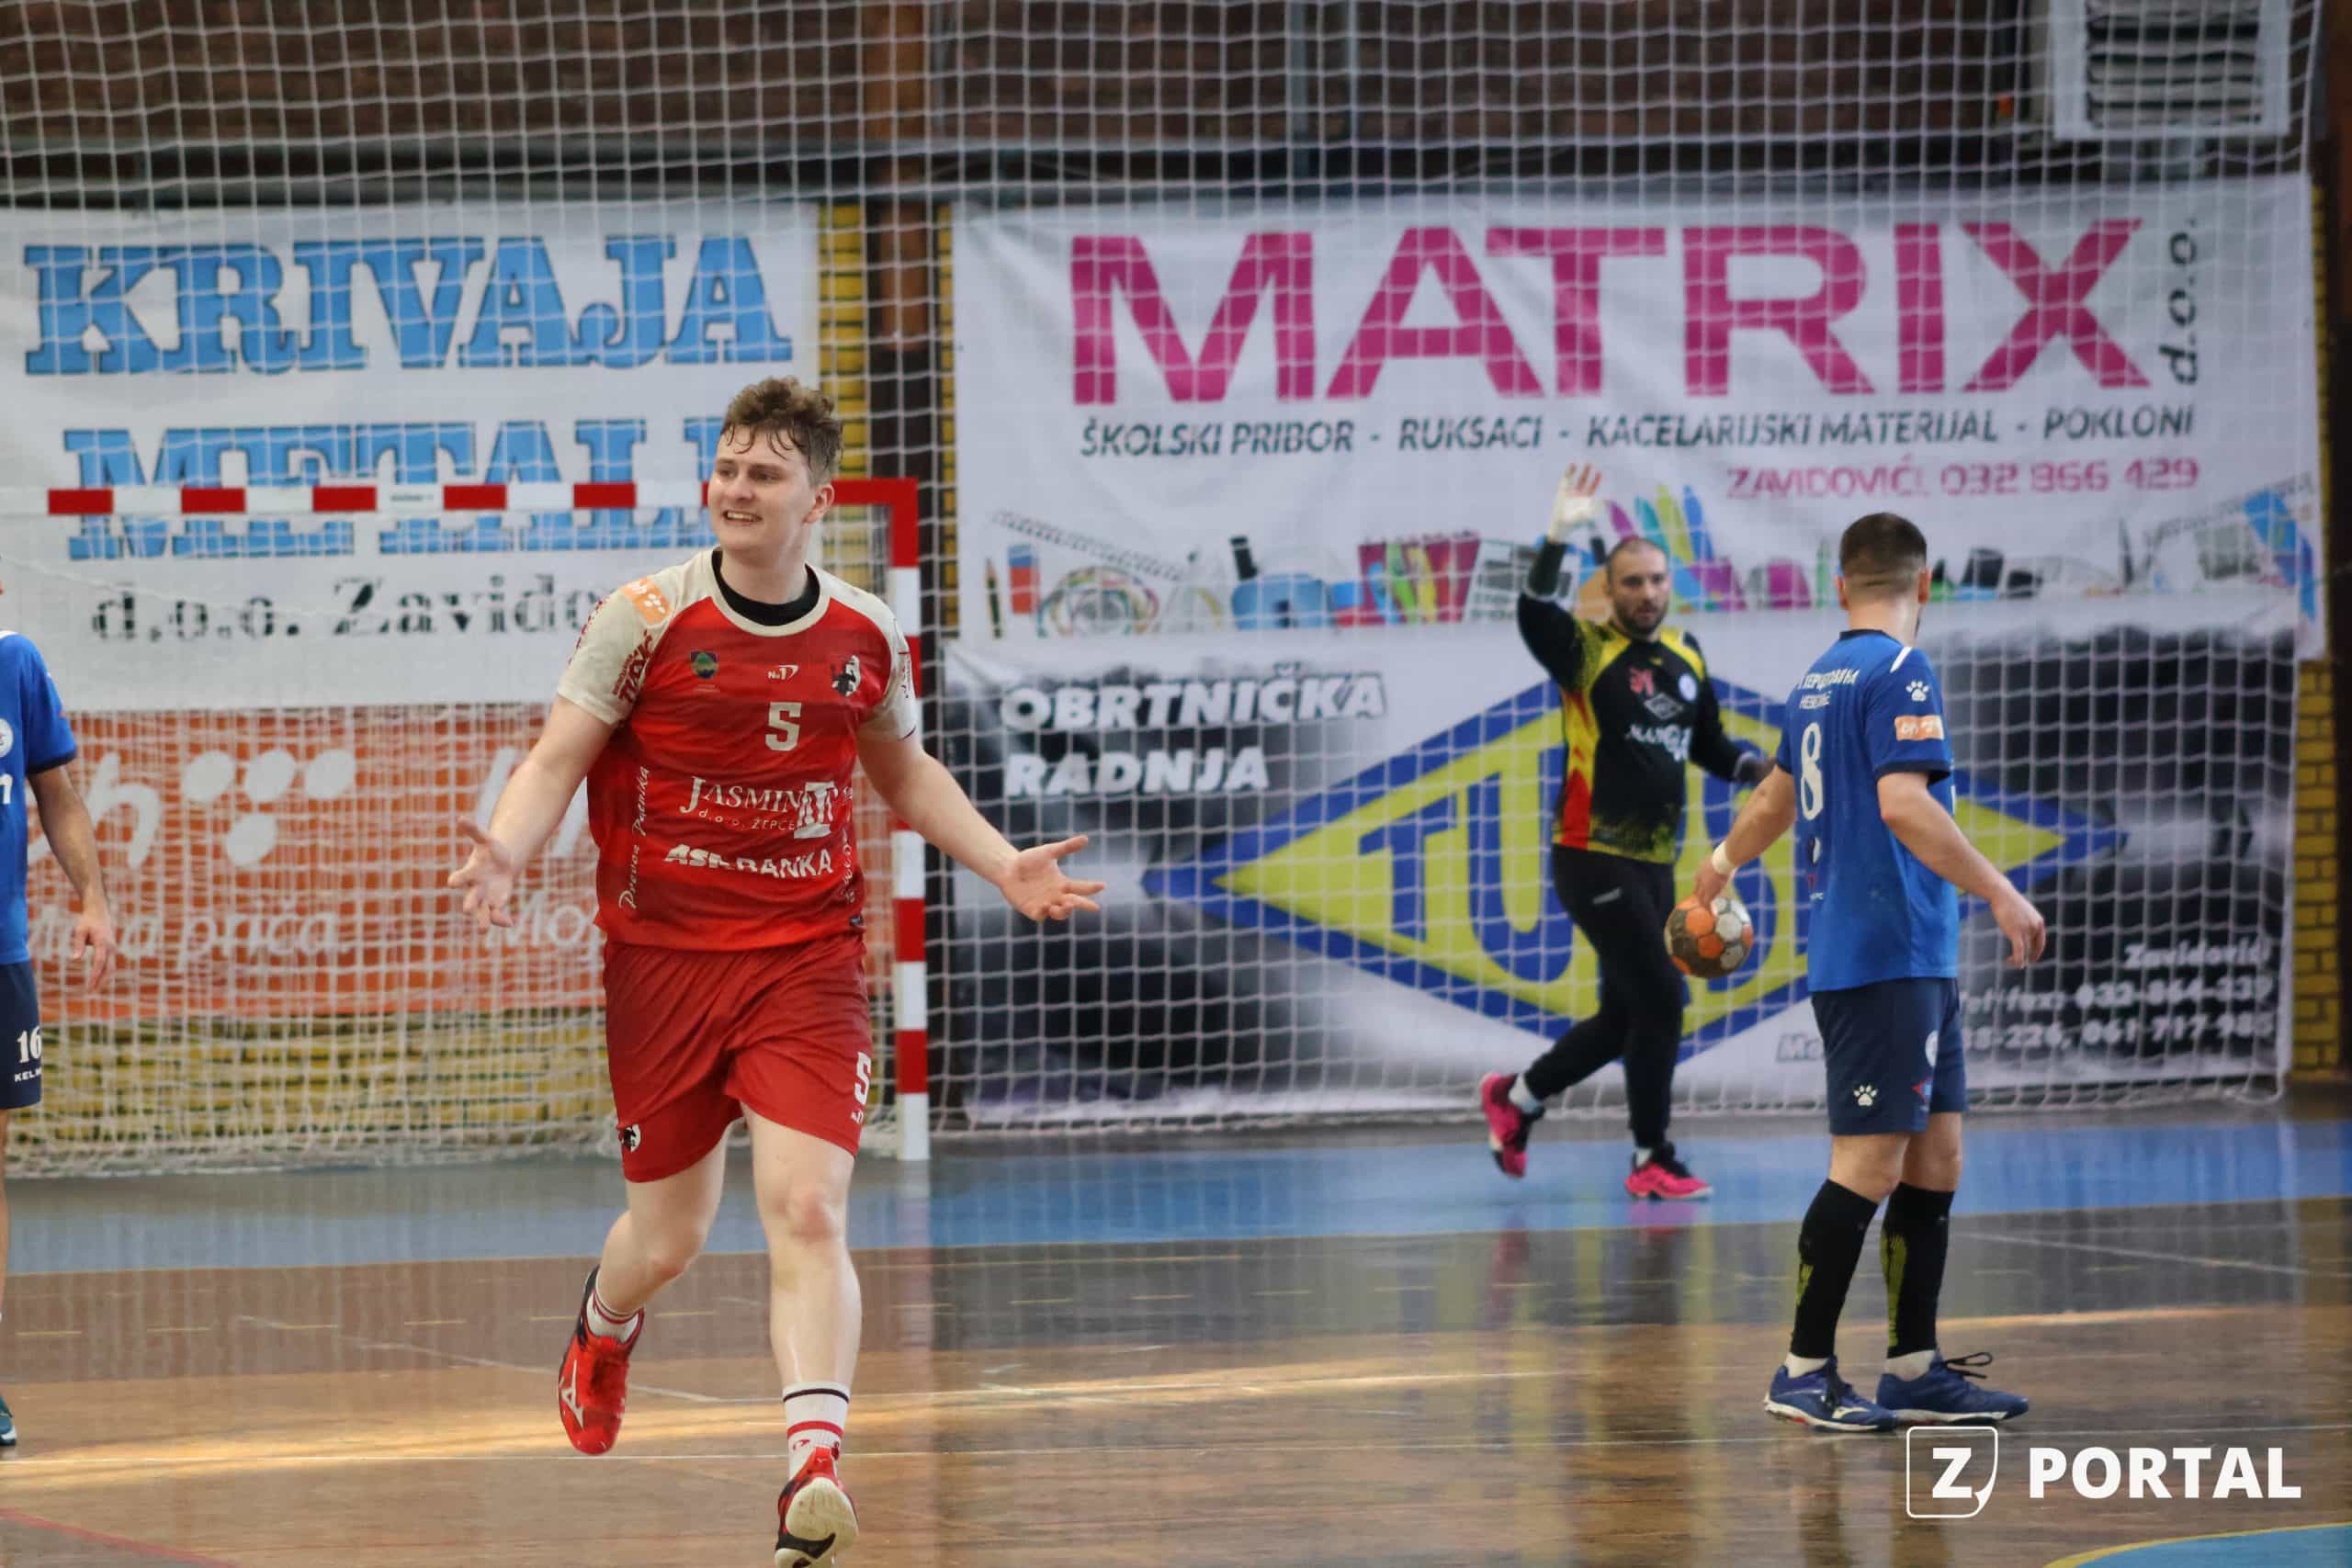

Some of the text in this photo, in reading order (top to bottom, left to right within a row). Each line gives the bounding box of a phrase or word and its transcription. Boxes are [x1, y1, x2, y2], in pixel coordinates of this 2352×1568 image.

[24, 234, 793, 375] KRIVAJA
[1070, 218, 2151, 405] MATRIX
[2160, 219, 2198, 386] d.o.o.
[1080, 419, 1222, 457] ŠKOLSKI
[1231, 418, 1354, 455] PRIBOR
[1398, 415, 1543, 452] RUKSACI
[1588, 410, 1818, 450] KACELARIJSKI
[1820, 408, 1998, 446] MATERIJAL
[2042, 402, 2193, 439] POKLONI
[1940, 464, 2018, 497] 032
[2124, 456, 2199, 491] 429
[91, 581, 300, 643] d.o.o.
[1001, 663, 1387, 730] OBRTNIČKA
[765, 701, 802, 751] 5
[1008, 746, 1270, 796] RADNJA
[1800, 722, 1824, 820] 8
[17, 1025, 42, 1064] 16
[854, 1052, 872, 1105] 5
